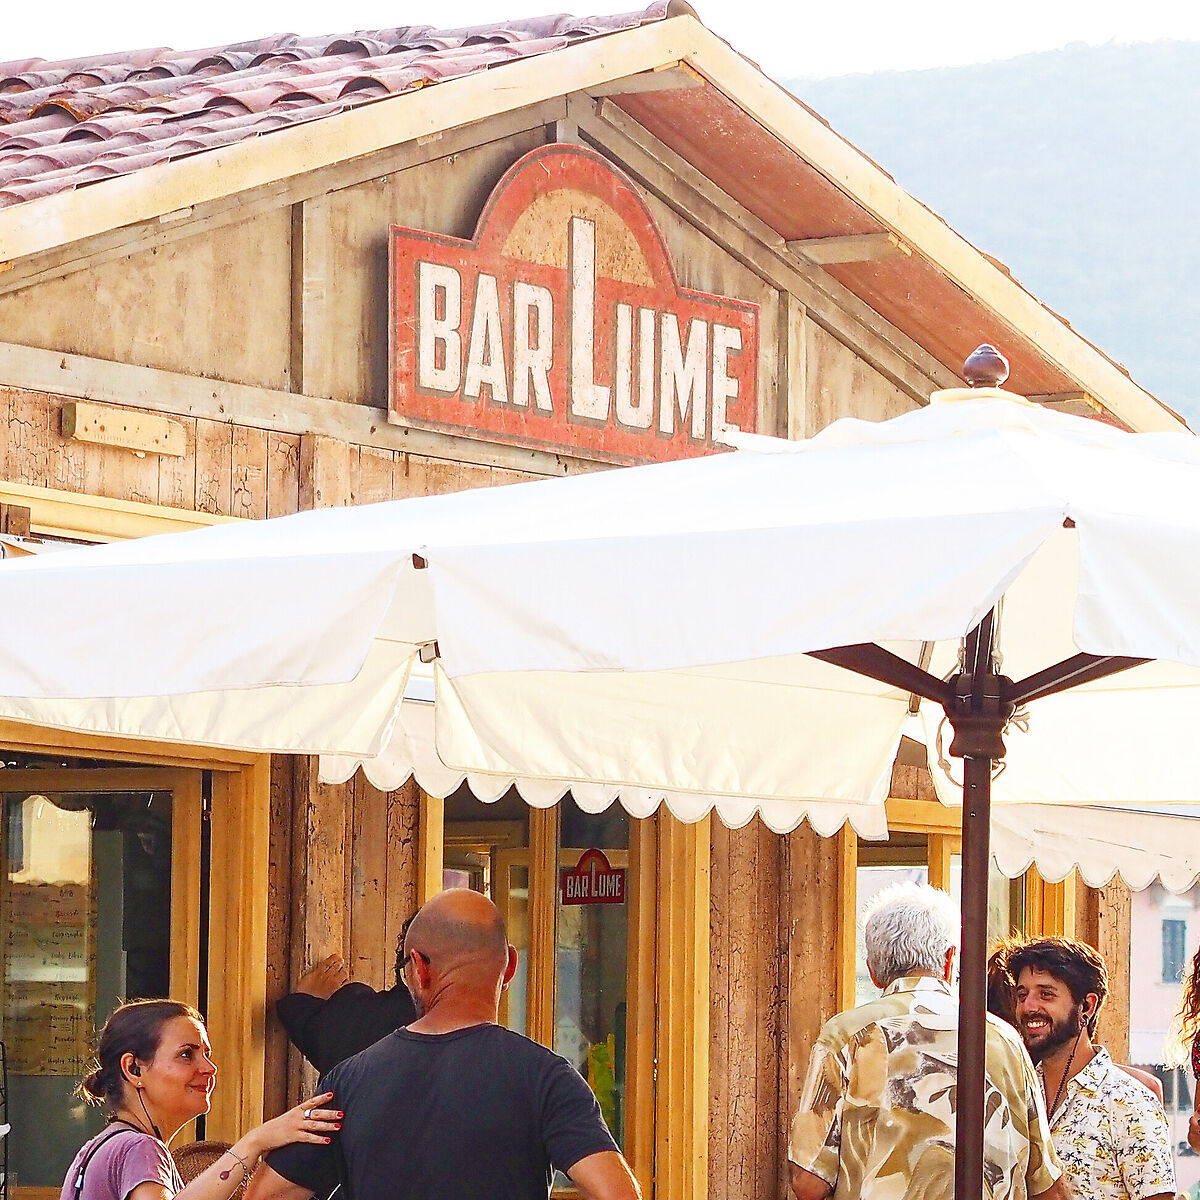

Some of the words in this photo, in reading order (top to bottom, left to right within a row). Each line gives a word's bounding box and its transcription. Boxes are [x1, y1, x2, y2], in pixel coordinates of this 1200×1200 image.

[418, 261, 555, 414] BAR
[570, 216, 743, 444] LUME
[566, 875, 589, 898] BAR
[590, 861, 622, 898] LUME
